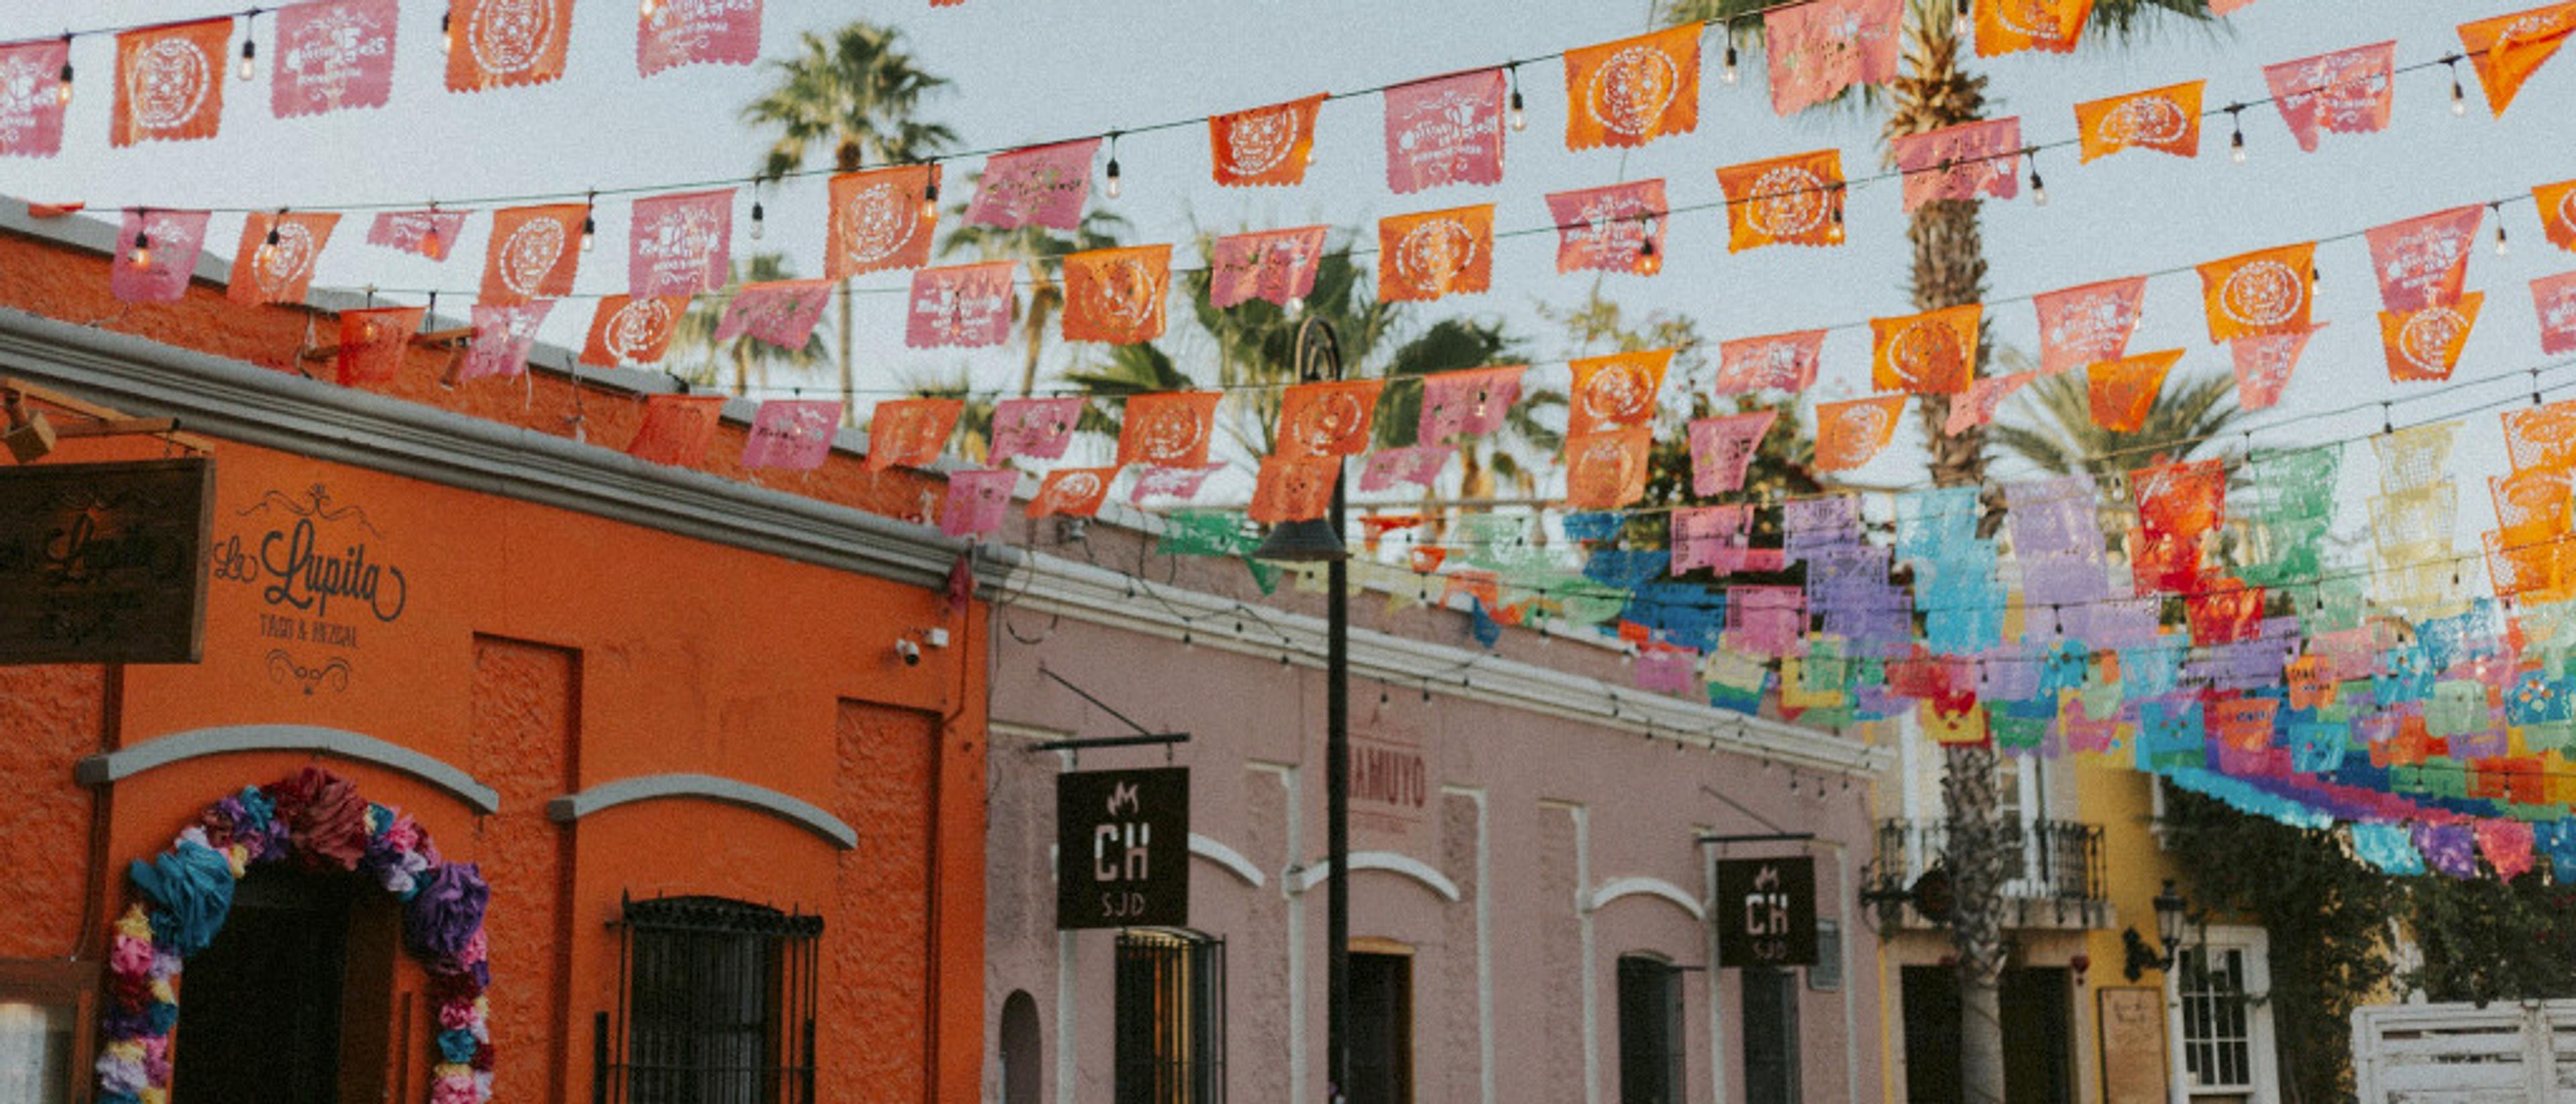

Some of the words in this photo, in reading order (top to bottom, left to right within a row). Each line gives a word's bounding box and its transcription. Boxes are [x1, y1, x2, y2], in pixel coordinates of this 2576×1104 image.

[261, 518, 406, 622] Lupita
[260, 613, 294, 639] TACO
[311, 620, 360, 649] MEZCAL
[1326, 743, 1425, 808] AMUYO
[1094, 822, 1150, 881] CH
[1102, 891, 1144, 917] SJD
[1746, 893, 1788, 936] CH
